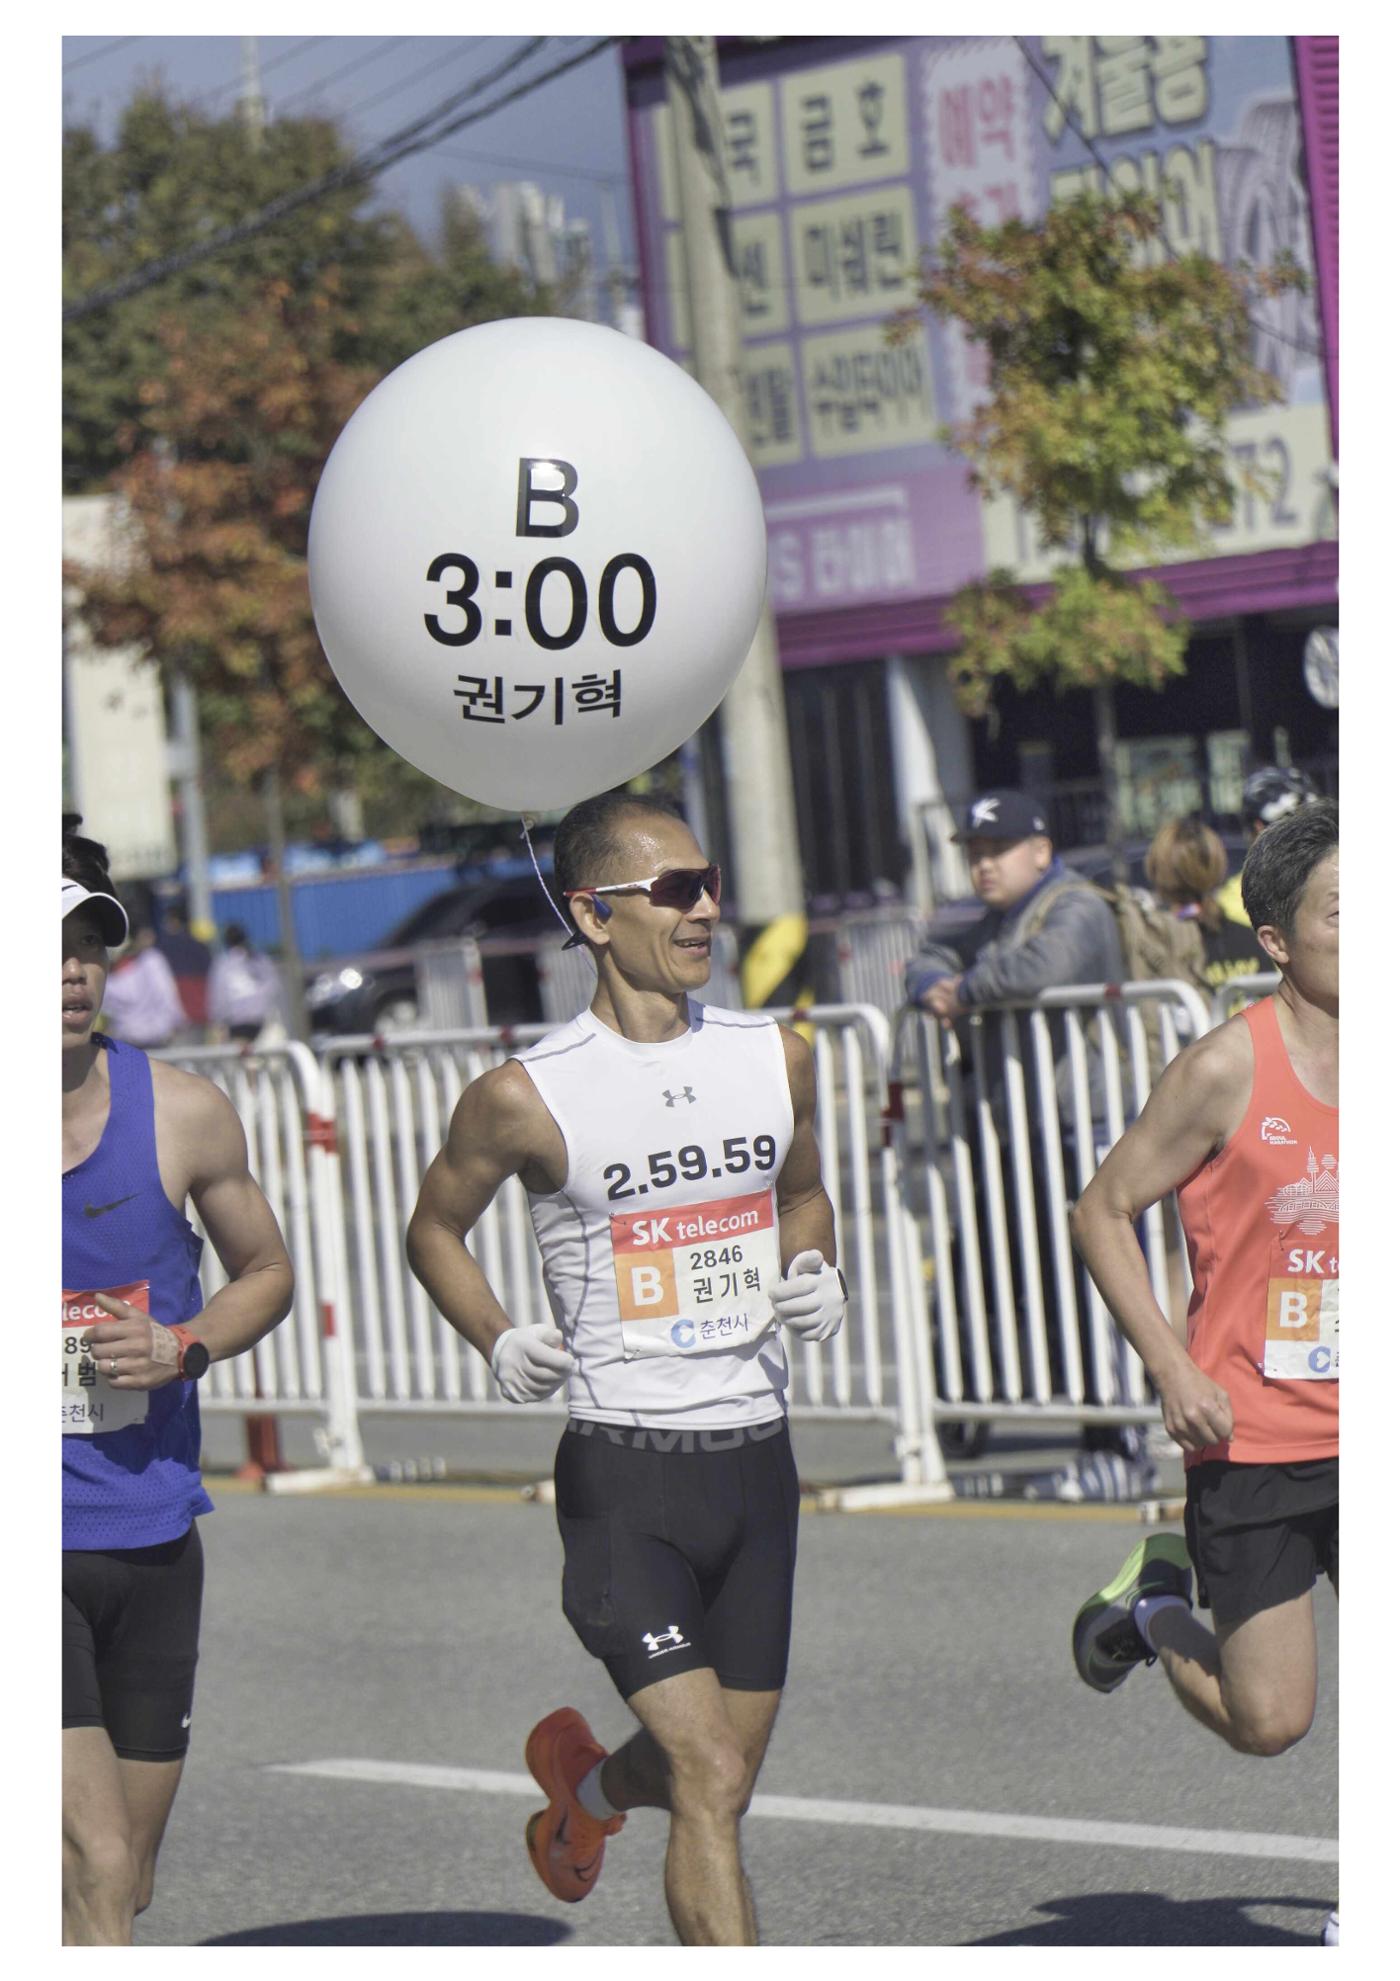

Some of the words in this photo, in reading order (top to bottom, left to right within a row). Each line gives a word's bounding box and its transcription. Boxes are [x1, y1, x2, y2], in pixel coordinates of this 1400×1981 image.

[727, 108, 760, 185] 국
[516, 457, 580, 538] B
[424, 552, 657, 651] 3:00
[453, 669, 621, 725] 권기혁
[603, 1134, 776, 1201] 2.59.59
[632, 1217, 672, 1246] SK
[677, 1209, 759, 1240] telecom
[690, 1245, 743, 1270] 2846
[1287, 1248, 1325, 1274] SK
[631, 1266, 664, 1306] B
[700, 1313, 749, 1340] 춘천시
[1279, 1291, 1309, 1328] B
